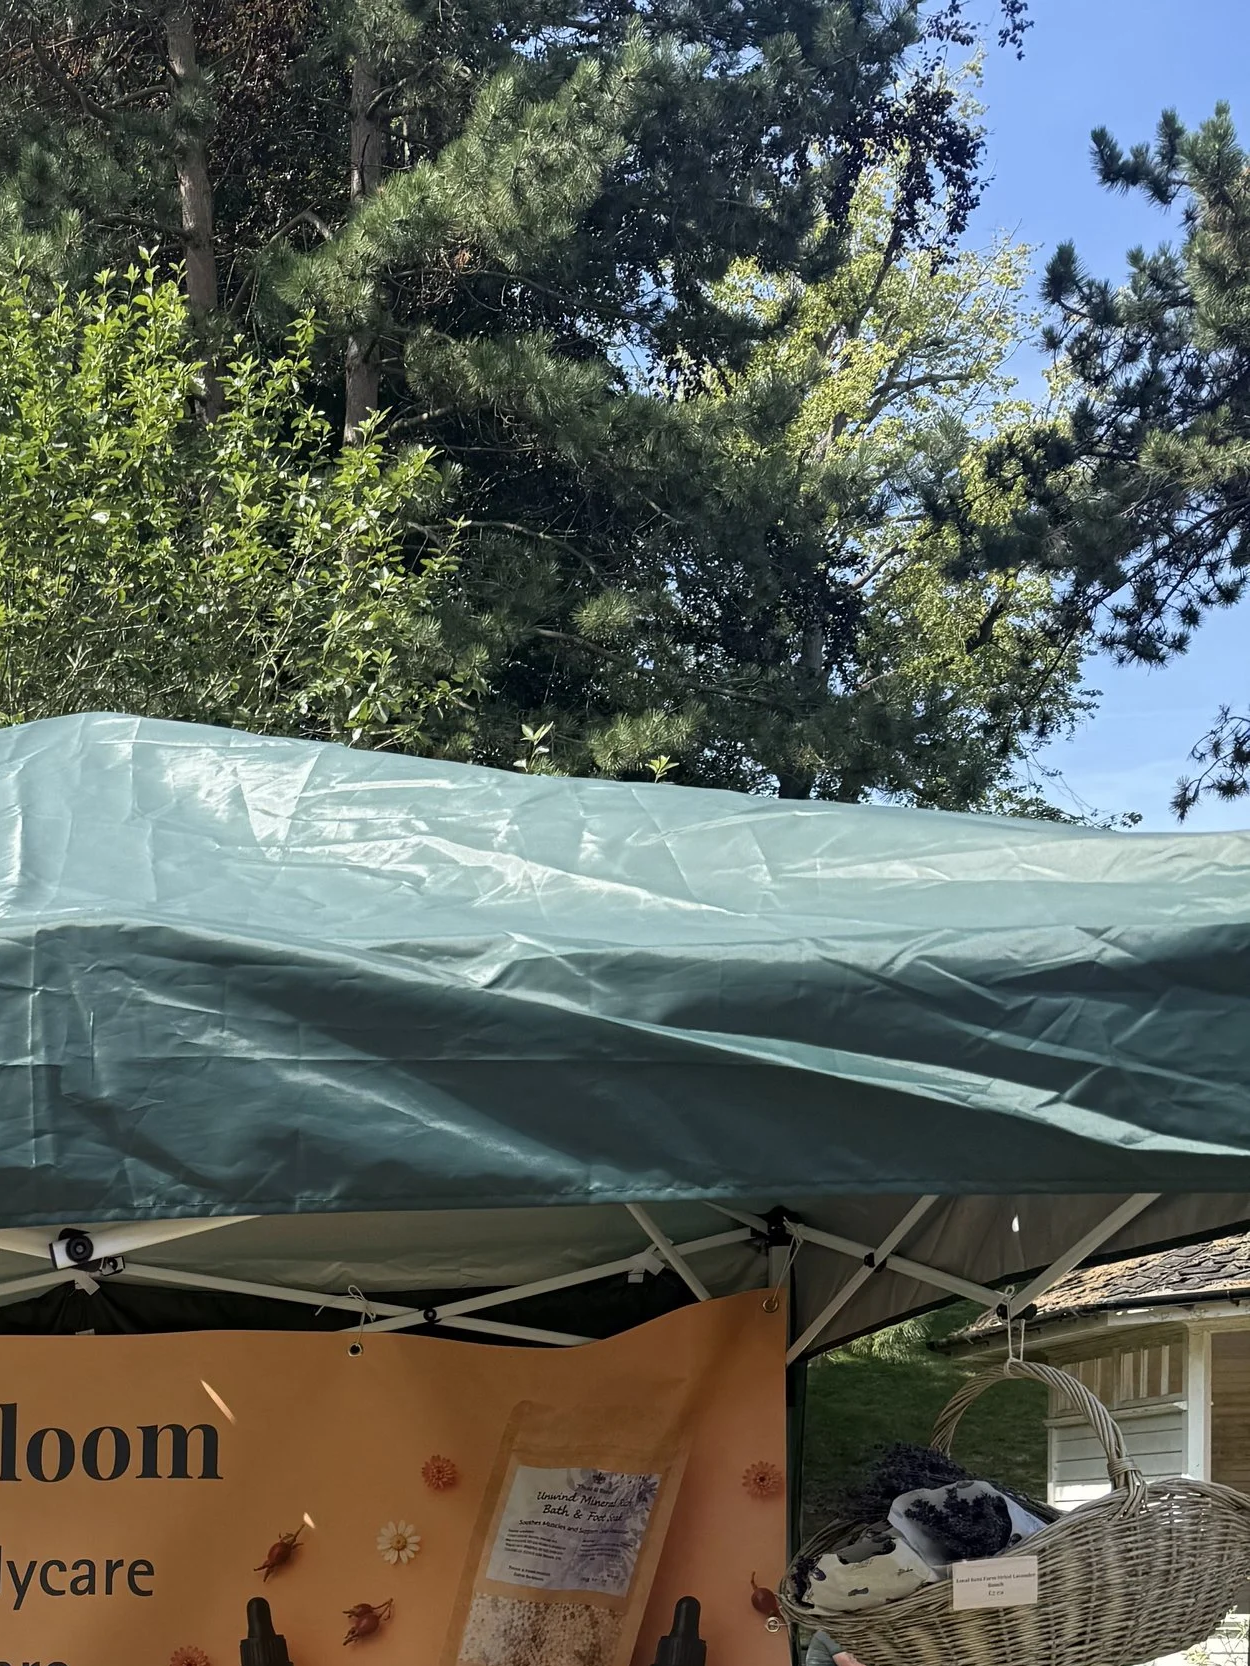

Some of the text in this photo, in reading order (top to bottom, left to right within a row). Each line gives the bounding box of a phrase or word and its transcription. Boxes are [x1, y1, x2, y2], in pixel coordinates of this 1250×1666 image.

[536, 1491, 578, 1502] Unwind
[542, 1504, 570, 1517] Bath
[573, 1509, 583, 1519] &
[587, 1511, 606, 1522] Foot
